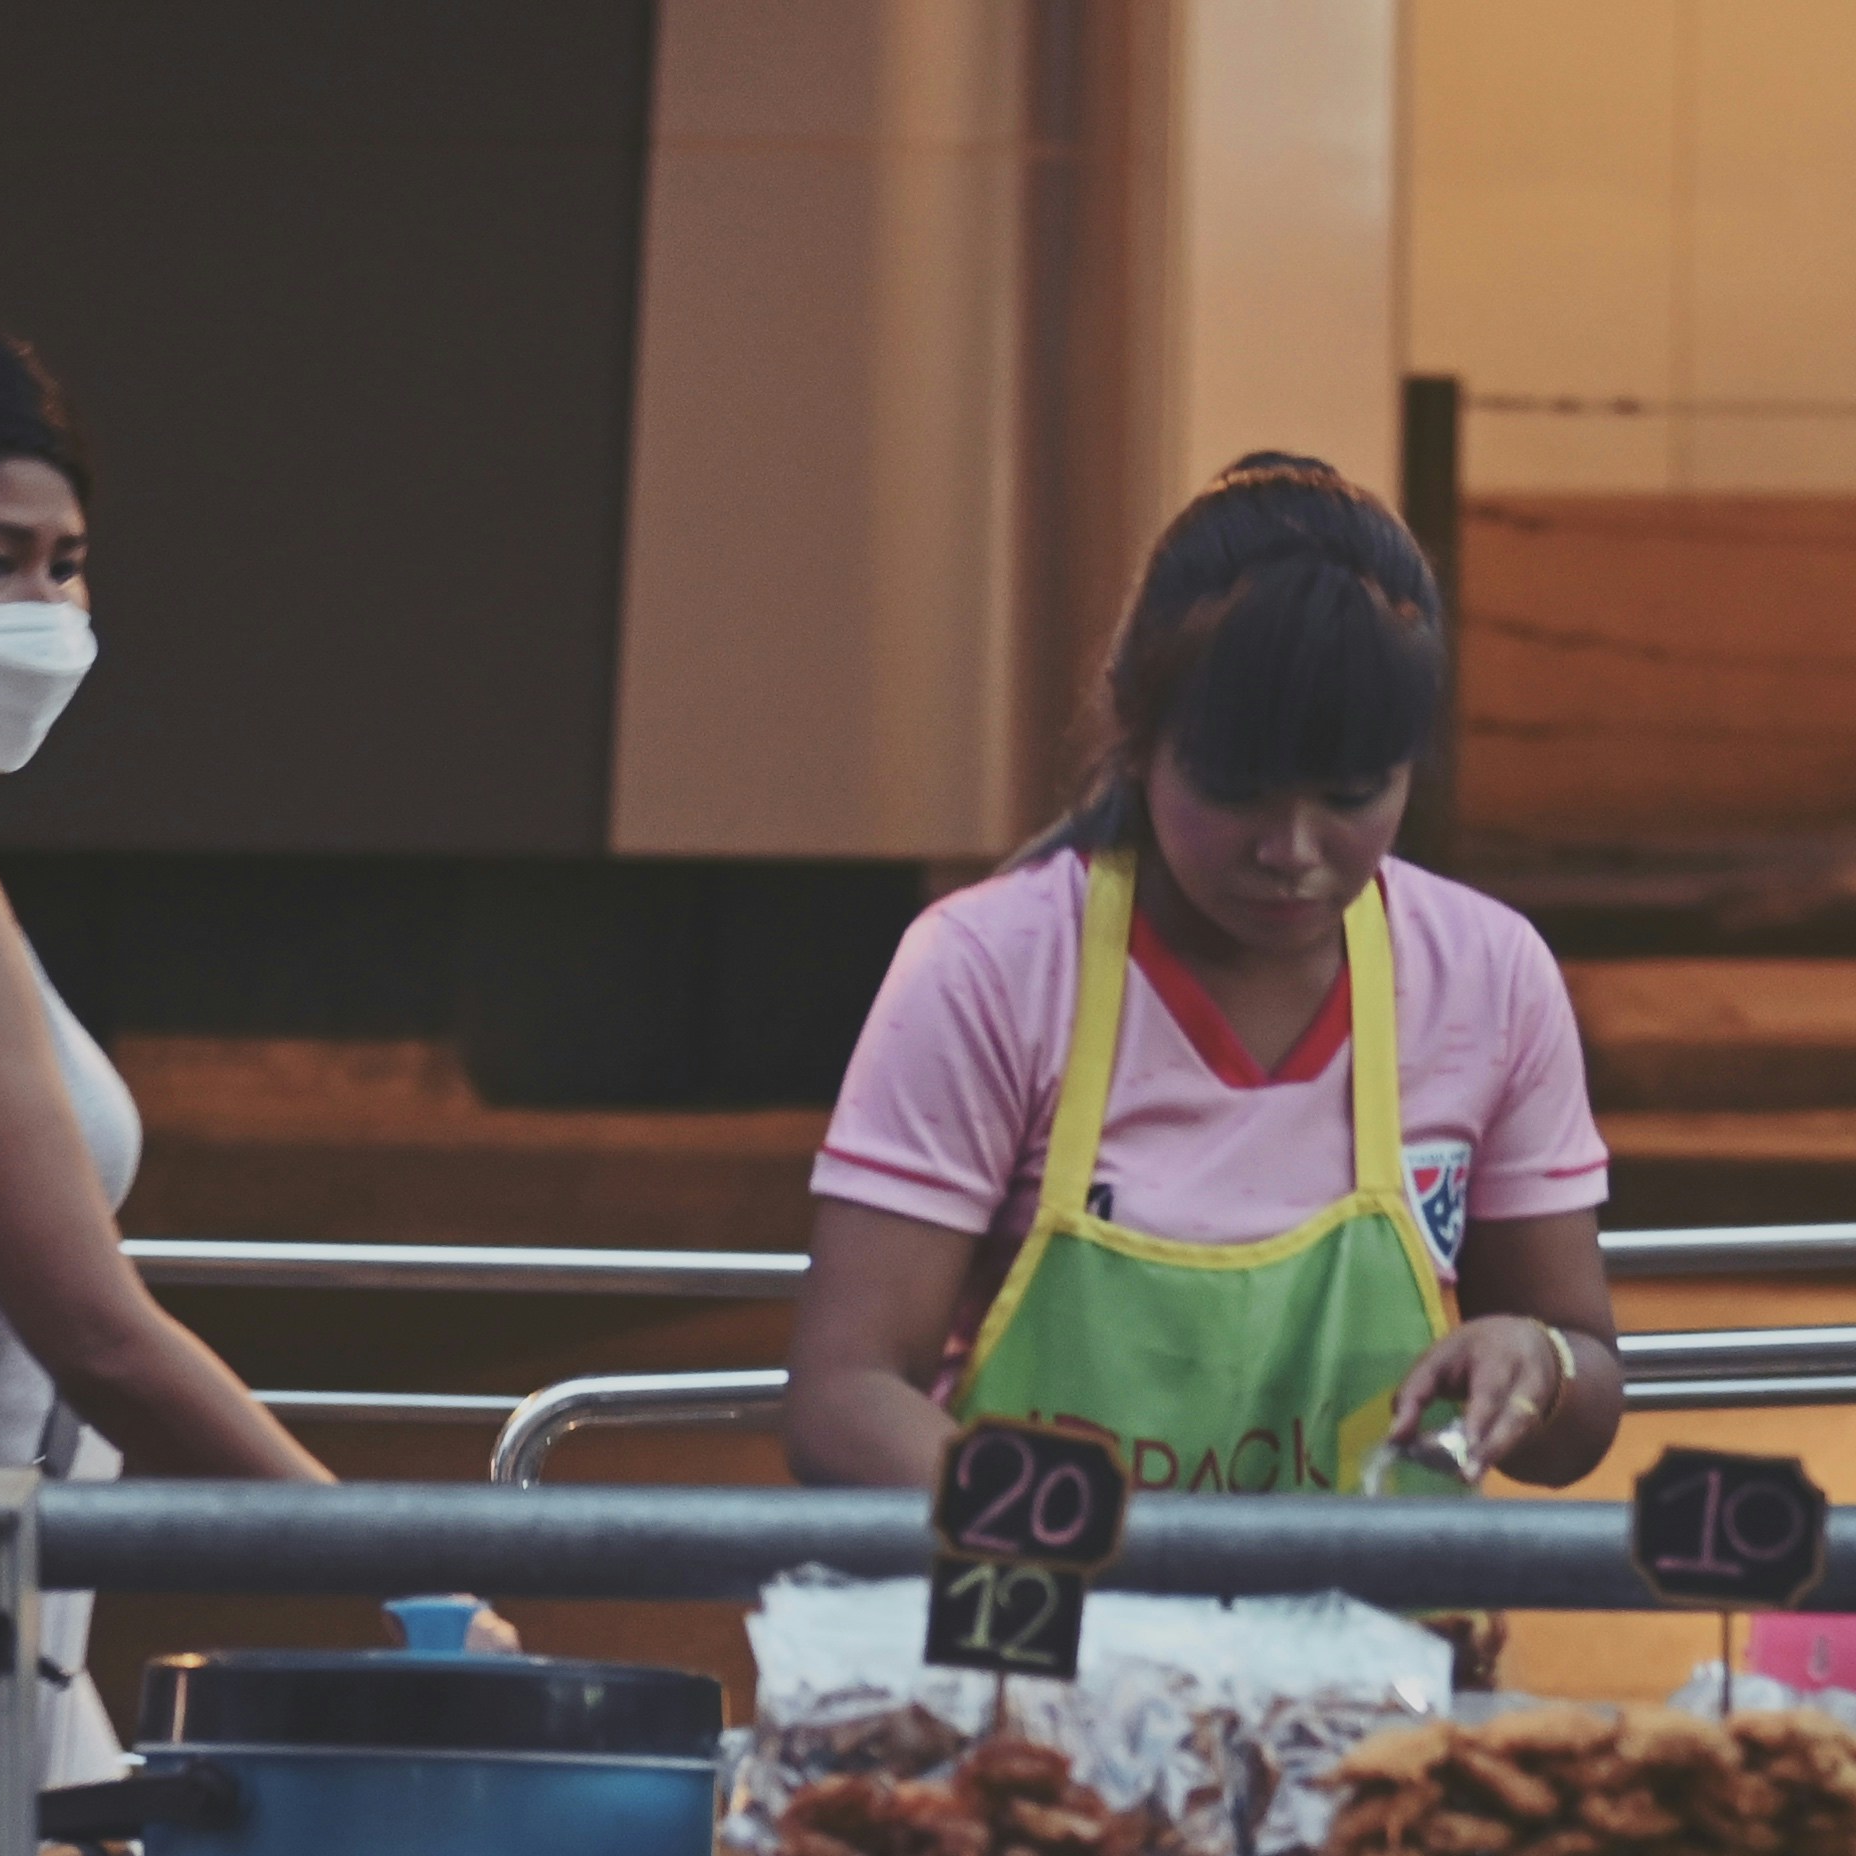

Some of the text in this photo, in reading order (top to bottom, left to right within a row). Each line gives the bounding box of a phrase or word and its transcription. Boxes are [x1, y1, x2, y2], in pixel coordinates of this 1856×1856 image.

[955, 1430, 1090, 1551] 20
[1654, 1466, 1805, 1577] 10
[948, 1563, 1060, 1666] 12
